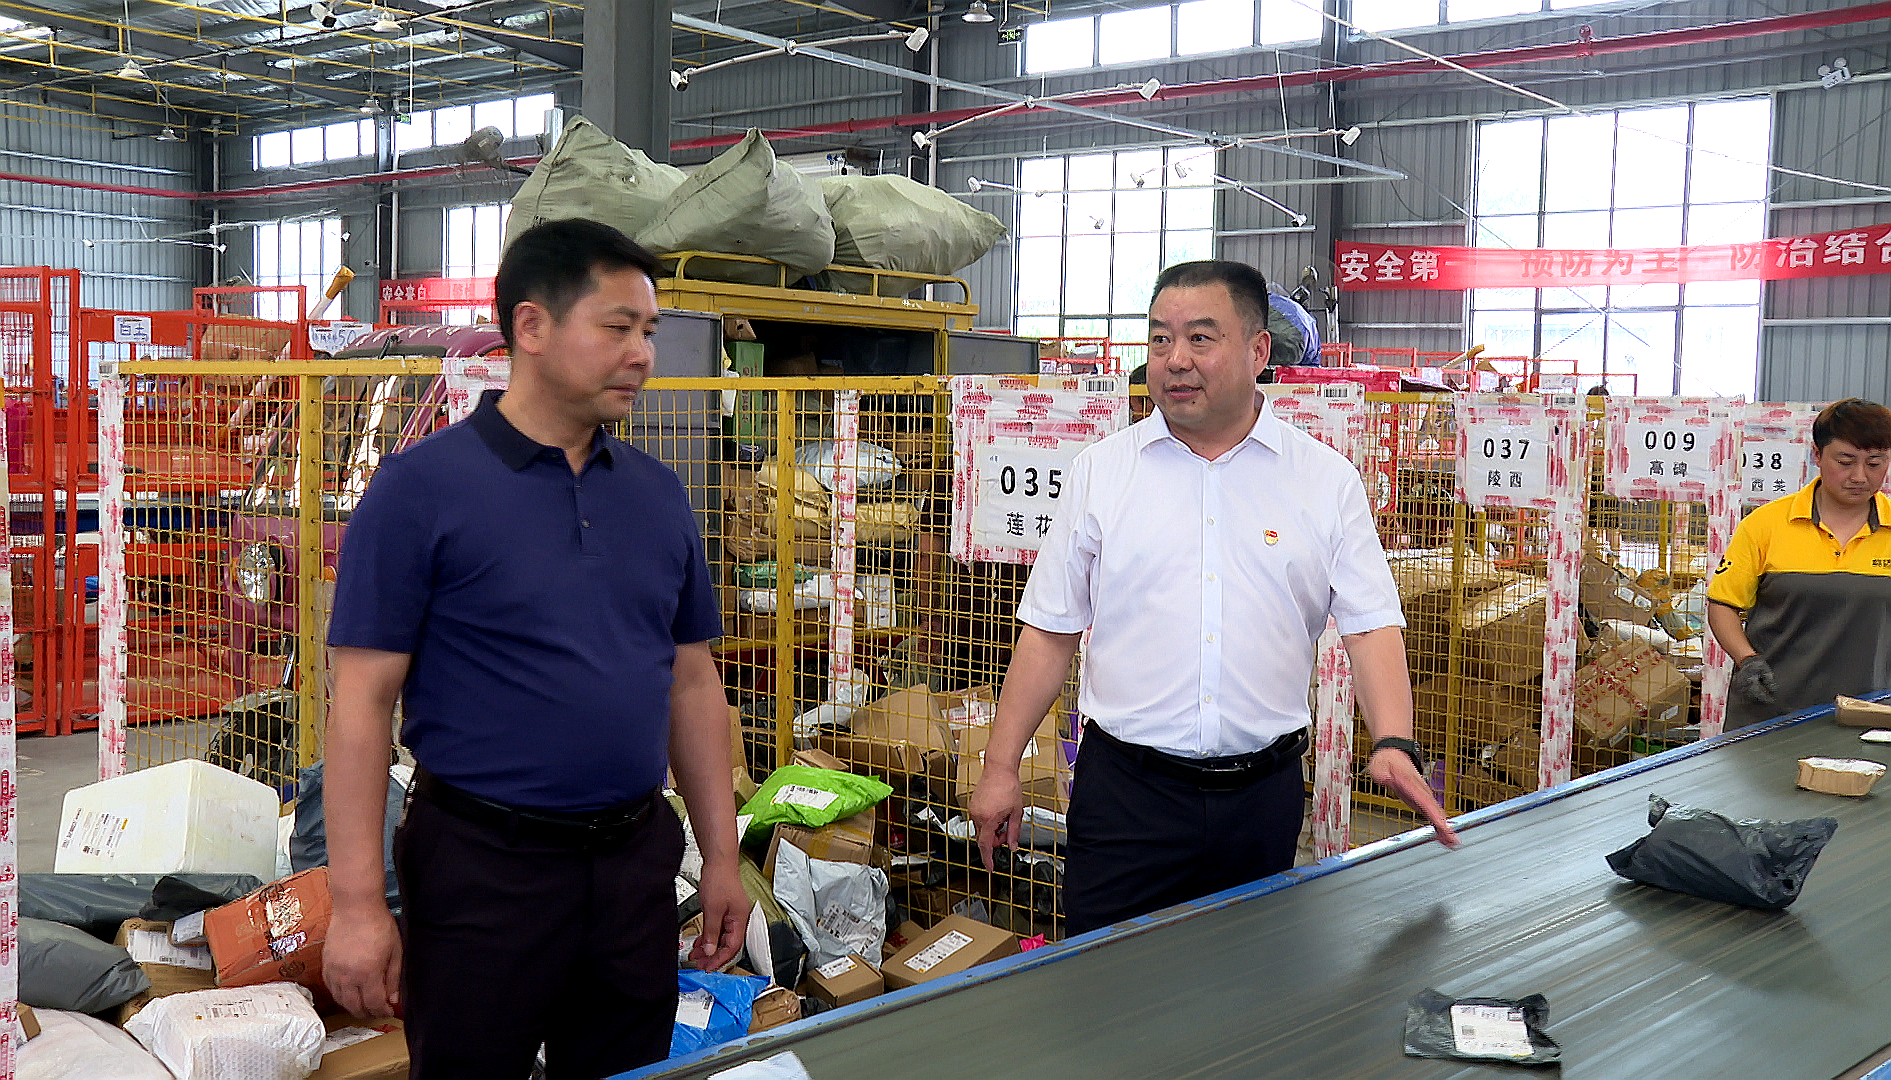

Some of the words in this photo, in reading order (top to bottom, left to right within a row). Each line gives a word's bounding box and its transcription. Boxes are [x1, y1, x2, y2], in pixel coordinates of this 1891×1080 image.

[1340, 249, 1477, 283] 安全第一
[1483, 438, 1530, 460] 037
[1645, 430, 1695, 451] 009
[1000, 465, 1062, 498] 035
